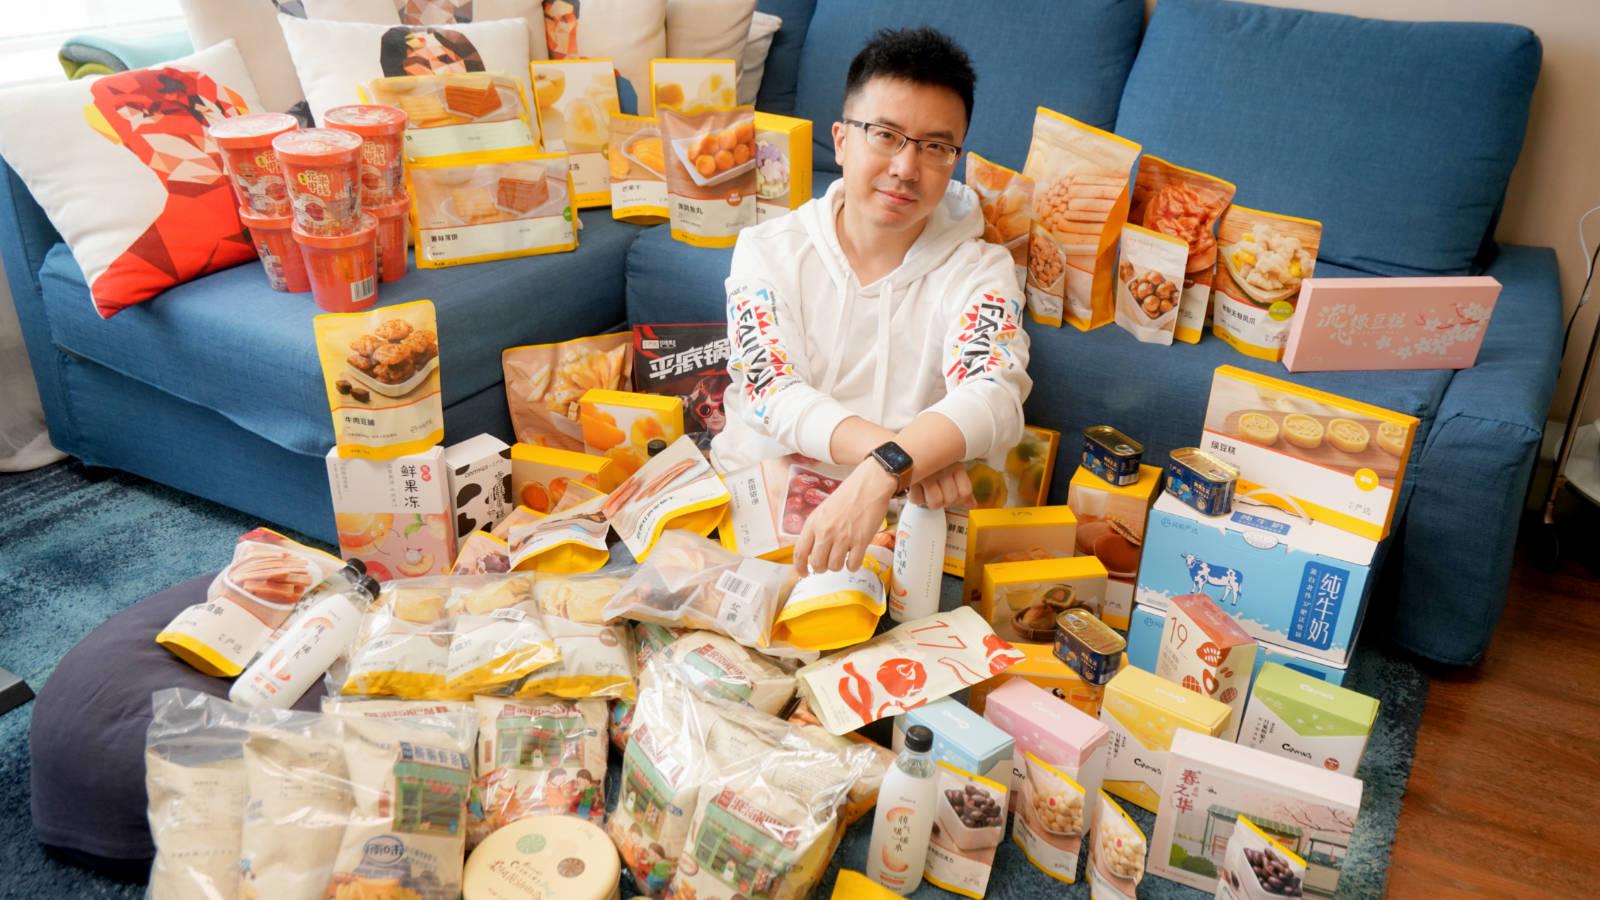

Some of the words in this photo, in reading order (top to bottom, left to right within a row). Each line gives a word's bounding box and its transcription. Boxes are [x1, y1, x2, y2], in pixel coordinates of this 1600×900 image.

[649, 338, 731, 380] 平底锅
[1210, 440, 1237, 456] 绿豆糕
[400, 464, 421, 509] 鲜果冻
[1239, 513, 1287, 531] 纯牛奶
[1308, 572, 1344, 645] 纯牛奶
[1170, 616, 1189, 650] 19
[1173, 769, 1201, 815] 春之华
